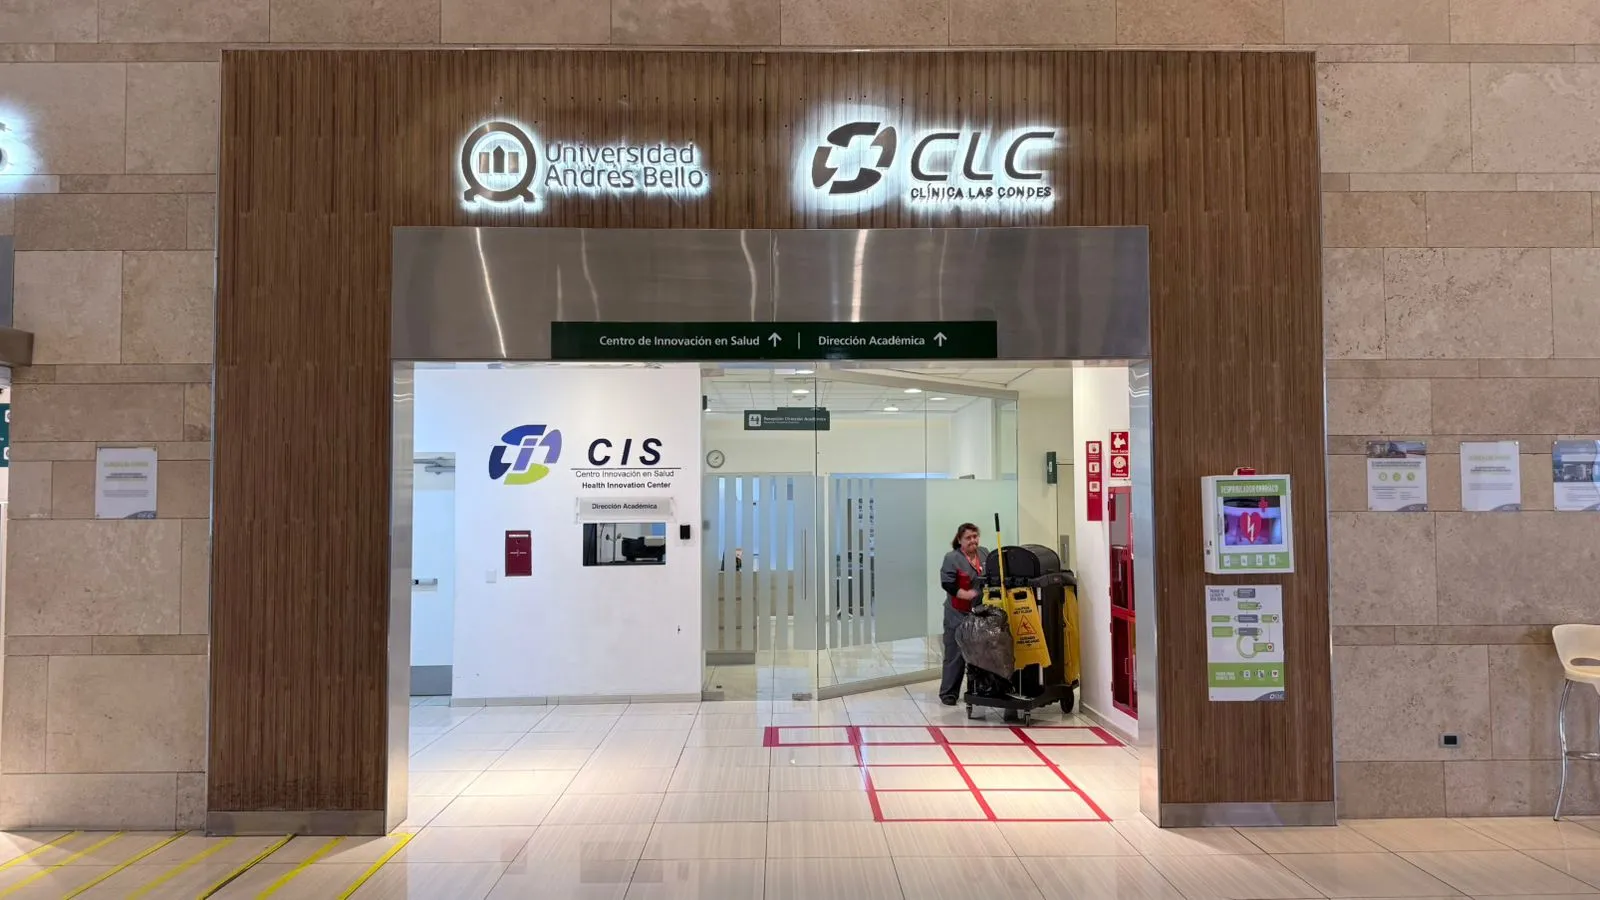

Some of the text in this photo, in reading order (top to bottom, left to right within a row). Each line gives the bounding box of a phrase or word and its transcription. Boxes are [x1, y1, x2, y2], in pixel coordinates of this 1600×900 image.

[545, 142, 695, 164] Universidad
[910, 131, 1056, 182] CLC
[544, 164, 704, 188] Andrés Bello
[910, 184, 1052, 199] CLÍNICA LAS CONDES
[599, 335, 760, 347] Centro de Innovación en Salud
[817, 335, 926, 347] Dirección Académica
[587, 437, 663, 467] CIS
[575, 470, 600, 478] Centro
[602, 470, 641, 478] Innovación
[647, 481, 671, 489] Center
